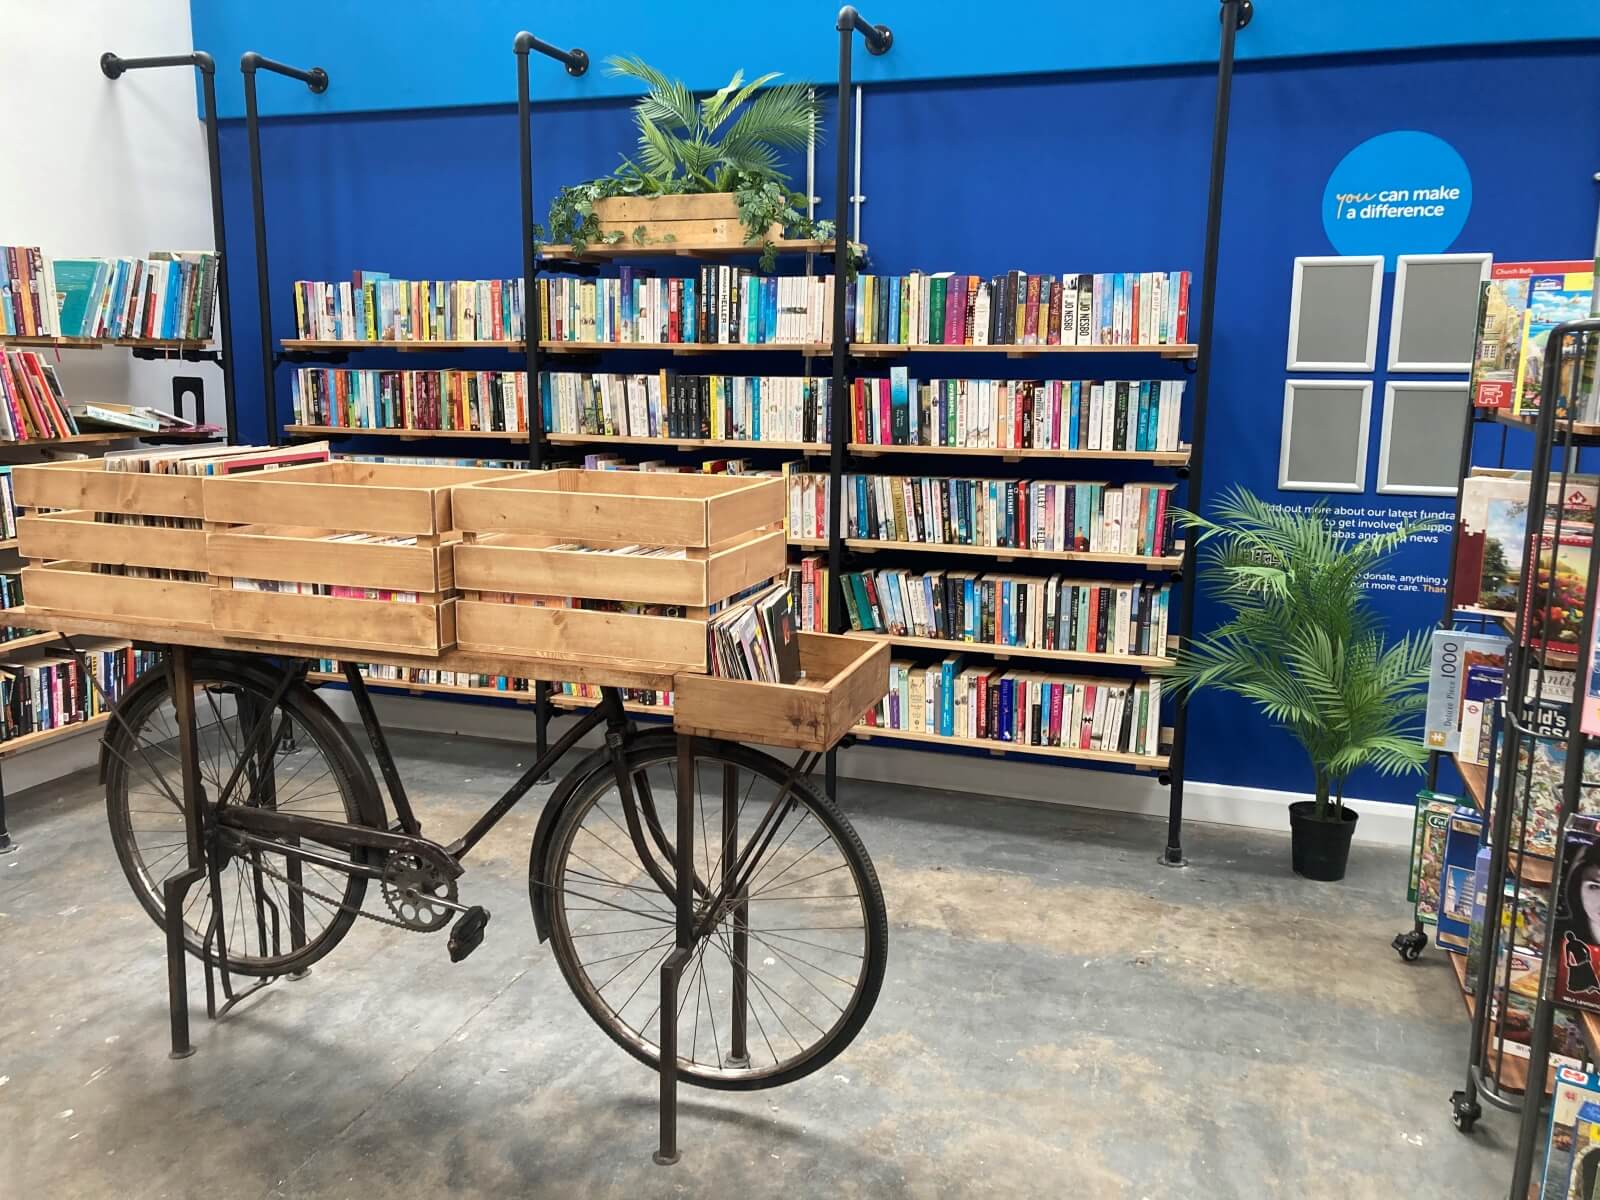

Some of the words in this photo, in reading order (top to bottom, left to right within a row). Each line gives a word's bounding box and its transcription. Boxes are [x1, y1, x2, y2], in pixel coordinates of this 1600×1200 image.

[1335, 193, 1377, 220] you
[1378, 189, 1409, 204] can
[1413, 185, 1460, 201] make
[1346, 207, 1357, 219] a
[1359, 204, 1445, 219] difference
[721, 294, 729, 323] HELLER
[1284, 504, 1302, 513] out
[1334, 506, 1364, 517] about
[1367, 509, 1386, 518] our
[1388, 508, 1418, 519] latest
[1338, 519, 1355, 528] get
[1409, 534, 1439, 544] news
[1363, 571, 1398, 583] donate,
[1399, 574, 1441, 586] anything
[1371, 582, 1396, 591] more
[1397, 584, 1420, 592] care.
[1440, 642, 1458, 679] 1000
